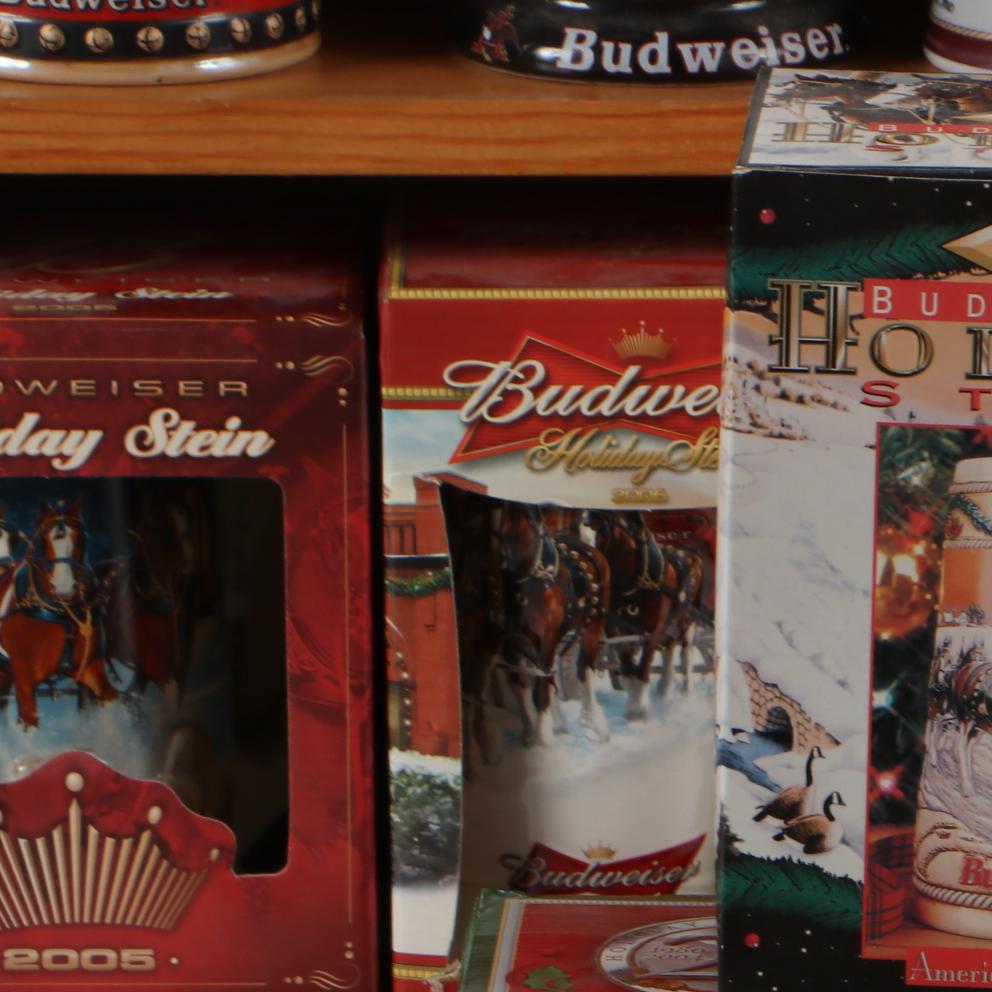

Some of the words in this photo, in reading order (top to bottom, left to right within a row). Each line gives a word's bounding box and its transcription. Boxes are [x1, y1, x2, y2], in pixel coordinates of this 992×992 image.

[0, 379, 250, 397] WEISER
[442, 359, 721, 424] Budwe
[124, 407, 276, 458] Stein
[525, 427, 668, 485] Holiday
[500, 853, 702, 890] Budweiser
[4, 948, 156, 972] 2005
